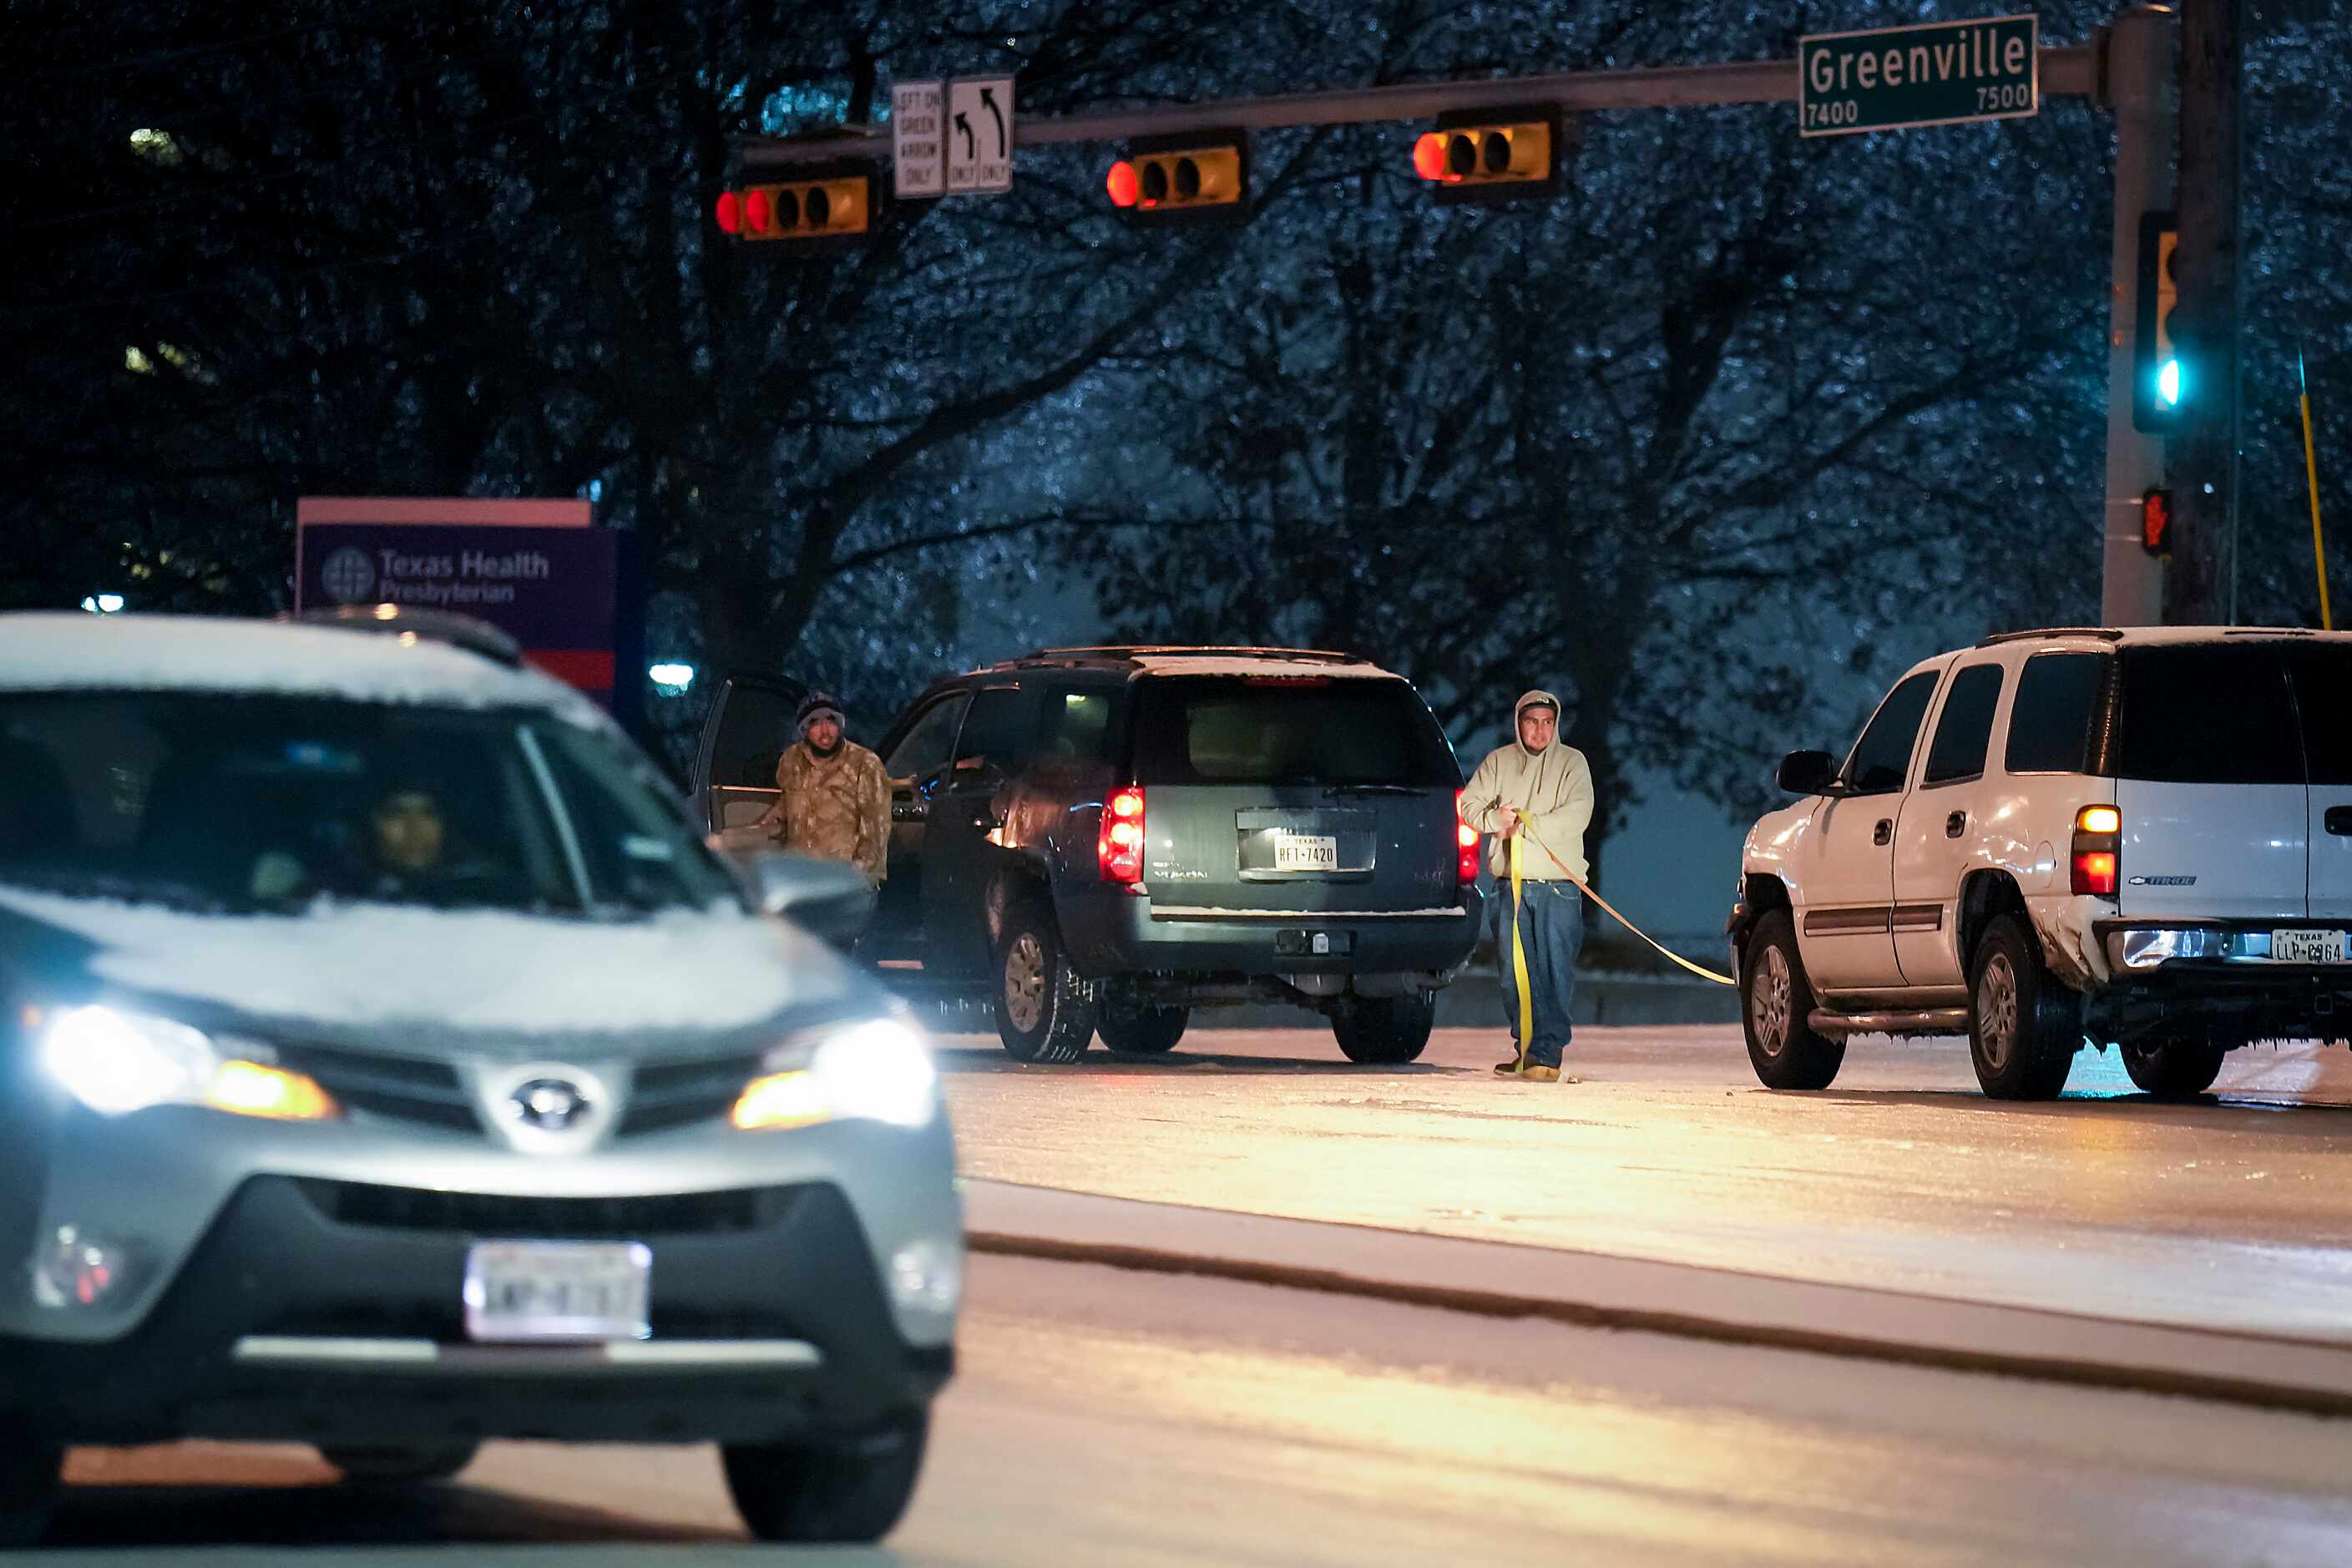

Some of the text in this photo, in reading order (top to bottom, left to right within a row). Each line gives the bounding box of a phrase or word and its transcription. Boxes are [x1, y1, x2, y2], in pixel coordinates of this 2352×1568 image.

[1809, 28, 2026, 94] Greenville
[1976, 83, 2030, 110] 7500
[1808, 100, 1859, 126] 7400
[380, 548, 549, 579] Texas Health
[379, 579, 516, 604] Presbyterian
